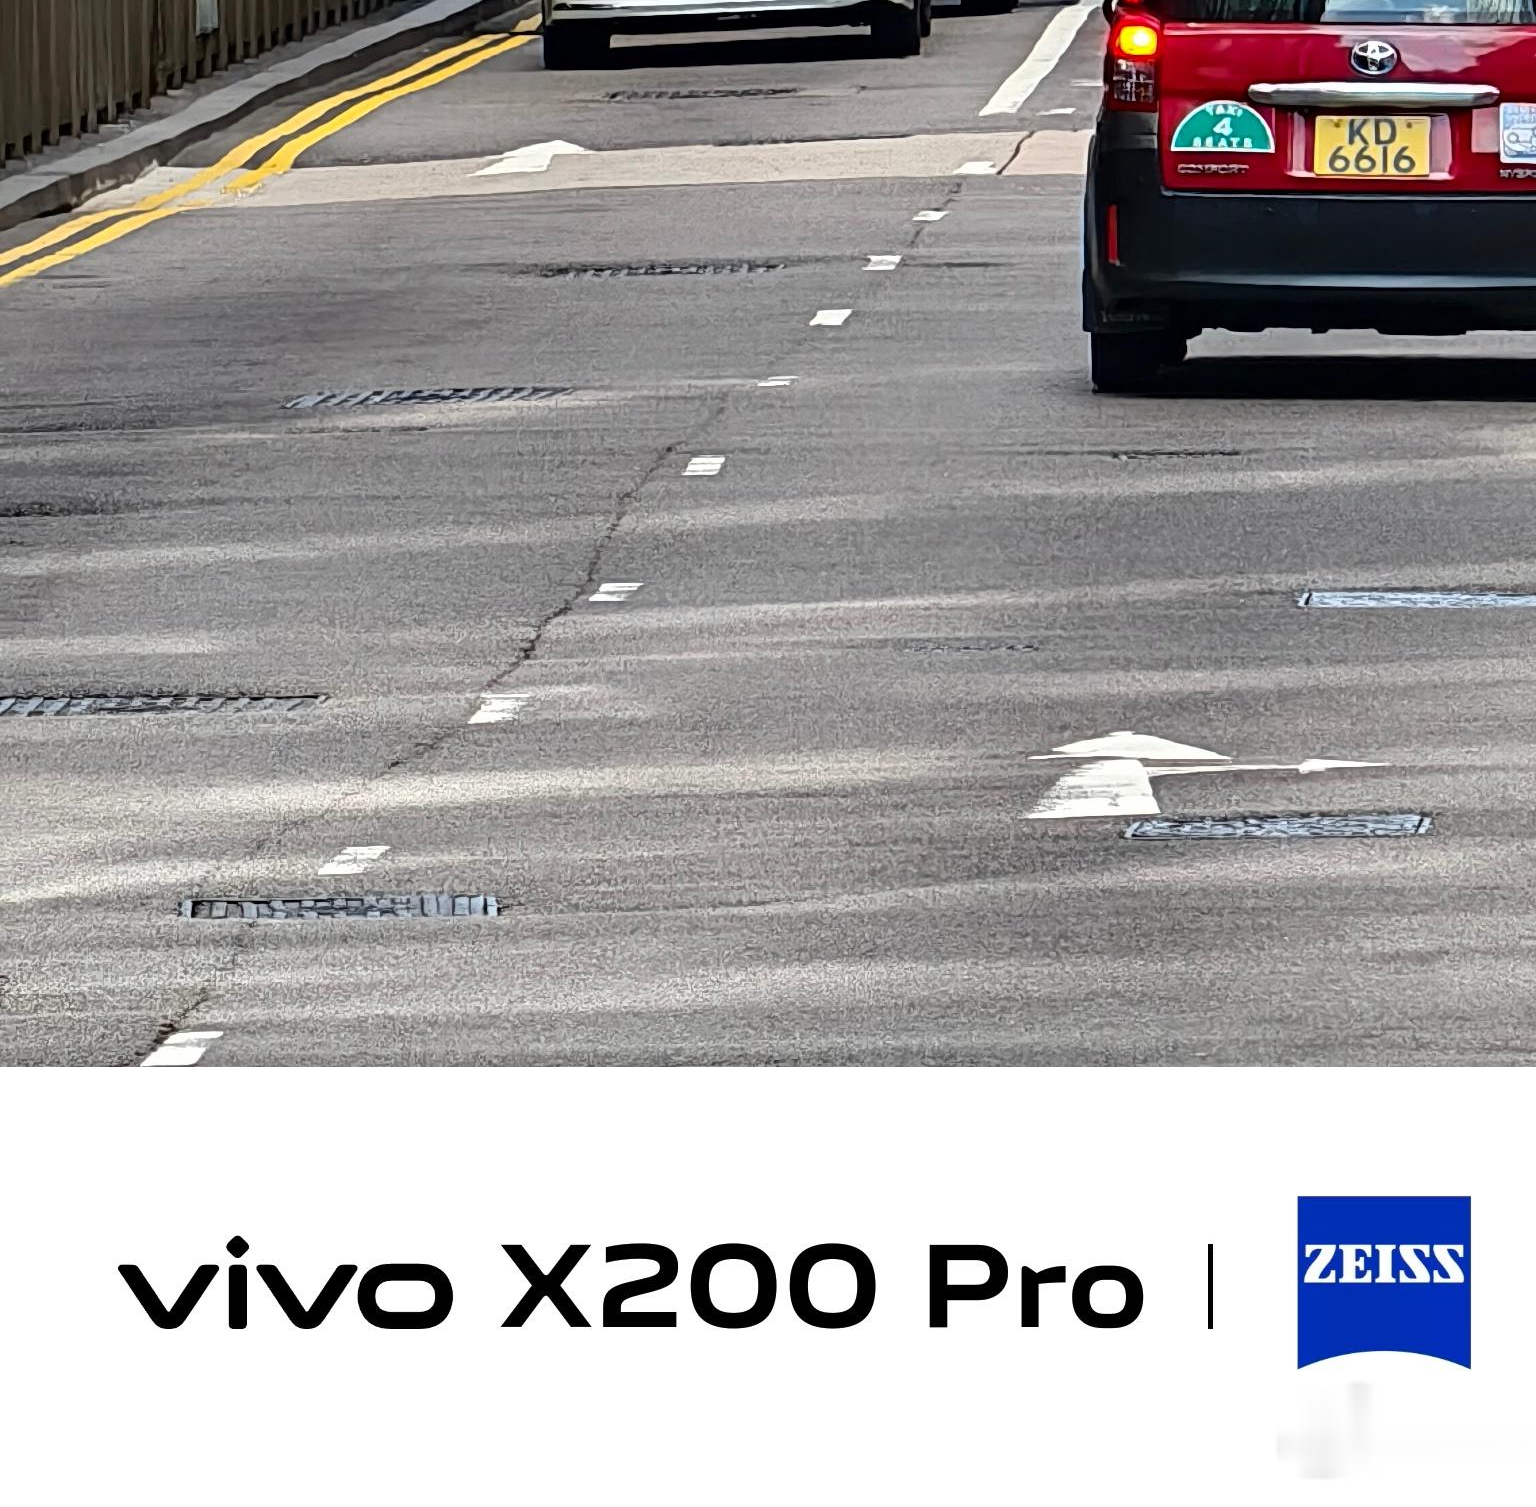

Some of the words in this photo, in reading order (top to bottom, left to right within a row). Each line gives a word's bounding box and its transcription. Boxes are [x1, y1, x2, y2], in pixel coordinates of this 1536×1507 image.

[1203, 104, 1244, 117] TAXI
[1212, 116, 1233, 136] 4
[1348, 118, 1397, 145] KD
[1192, 136, 1253, 149] SEATS
[1328, 145, 1417, 174] 6616
